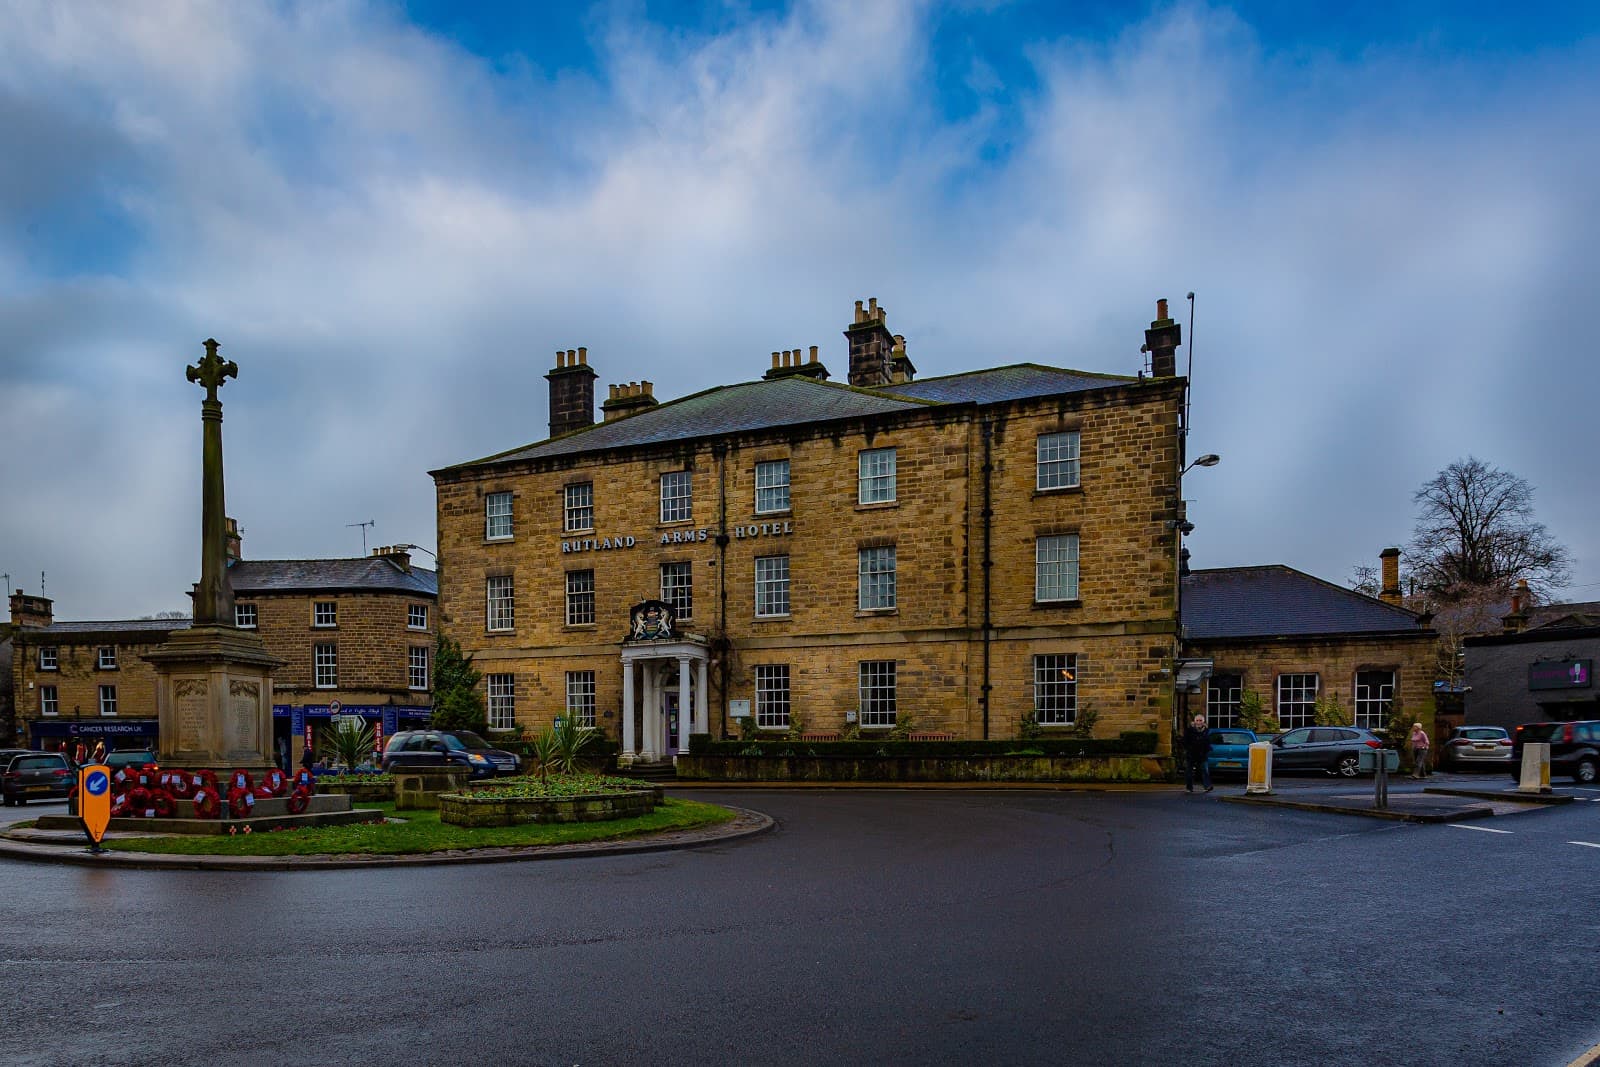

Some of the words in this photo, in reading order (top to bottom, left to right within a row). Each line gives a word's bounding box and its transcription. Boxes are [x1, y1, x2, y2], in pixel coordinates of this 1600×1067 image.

[562, 536, 636, 553] RUTLAND
[661, 528, 708, 544] ARMS
[735, 522, 793, 538] HOTEL
[375, 722, 383, 752] SALE
